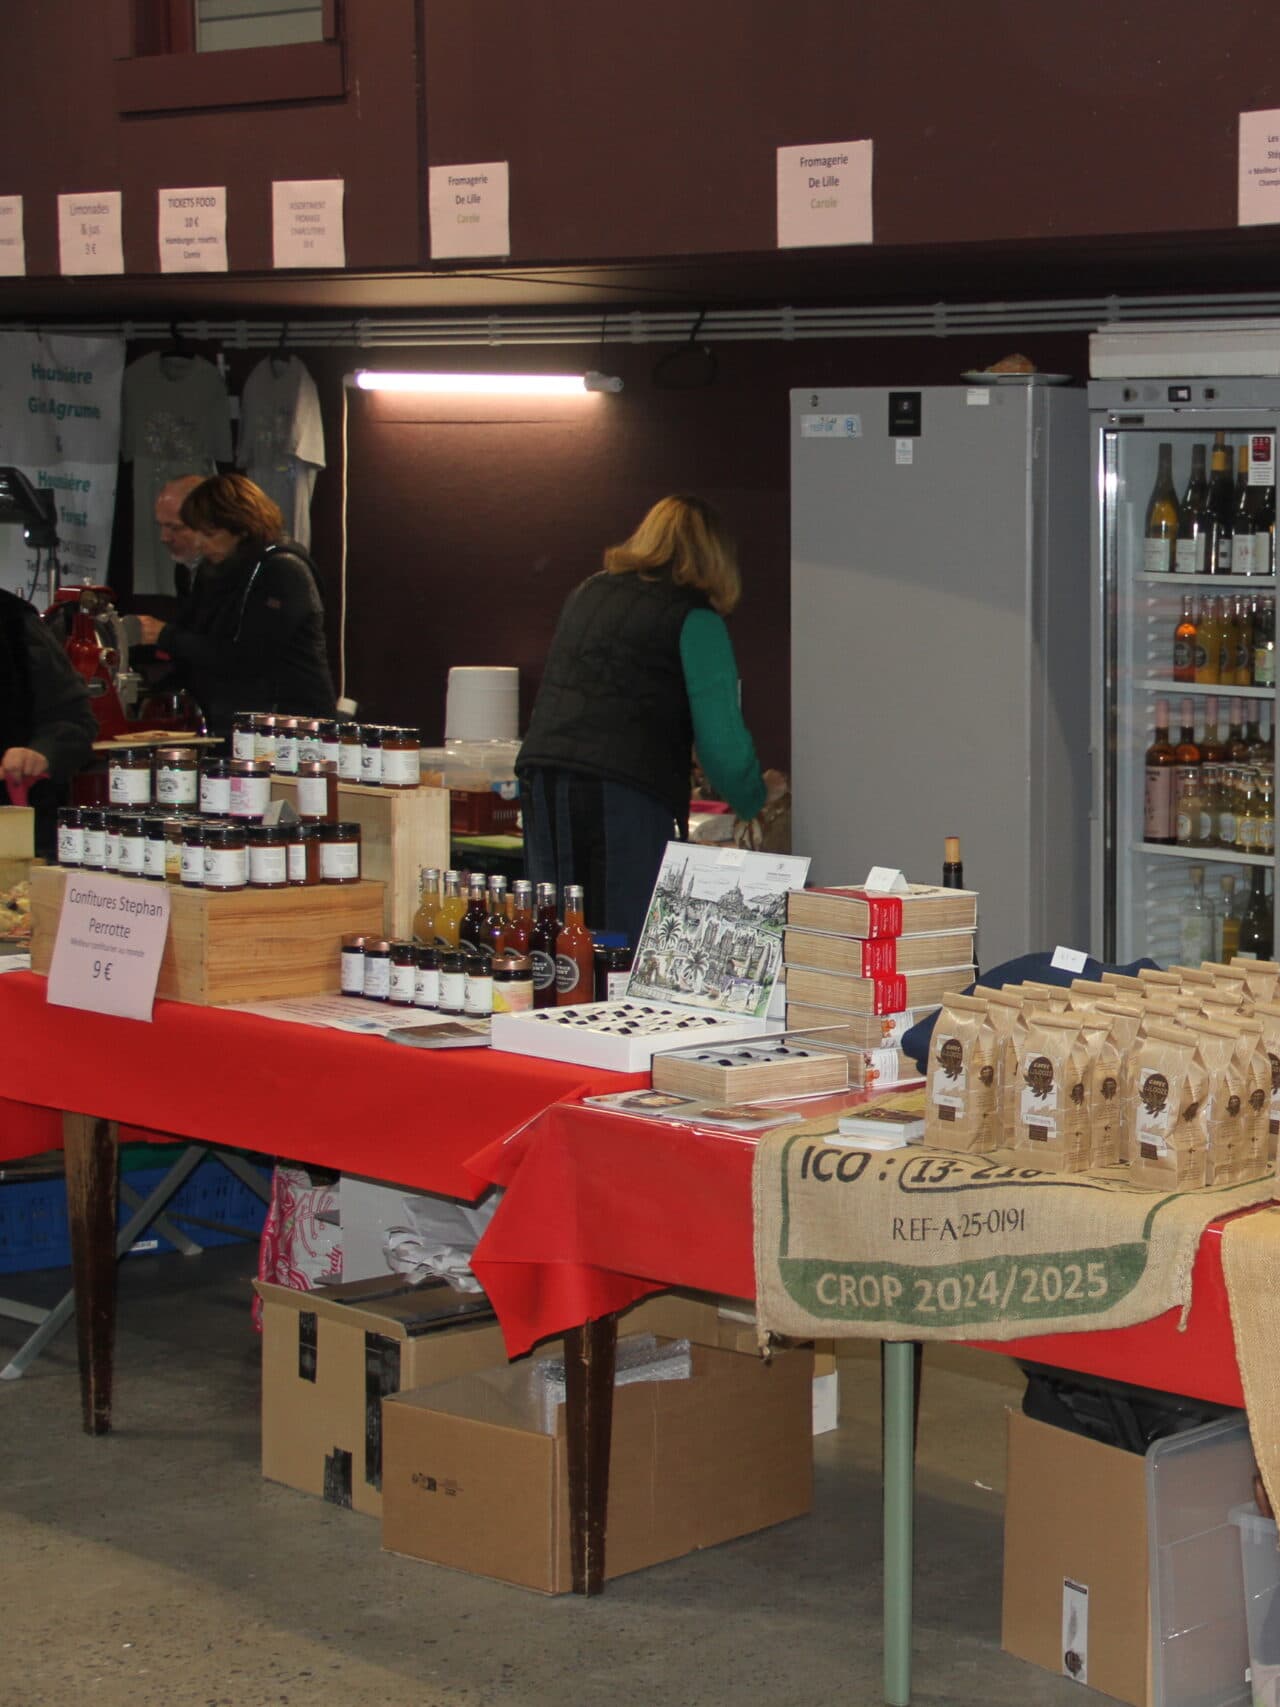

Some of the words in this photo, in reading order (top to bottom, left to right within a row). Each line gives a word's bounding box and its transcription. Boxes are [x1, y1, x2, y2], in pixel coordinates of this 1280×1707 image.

[800, 154, 849, 168] Fromagerie
[808, 177, 820, 188] De
[822, 176, 840, 187] Lille
[69, 888, 117, 910] Confitures
[119, 896, 163, 917] Stephan
[88, 917, 131, 938] Perrotte
[92, 960, 102, 979] 9
[104, 962, 113, 981] €
[800, 1145, 872, 1182] ICO
[815, 1272, 903, 1308] CROP
[914, 1262, 1109, 1314] 2024/2025
